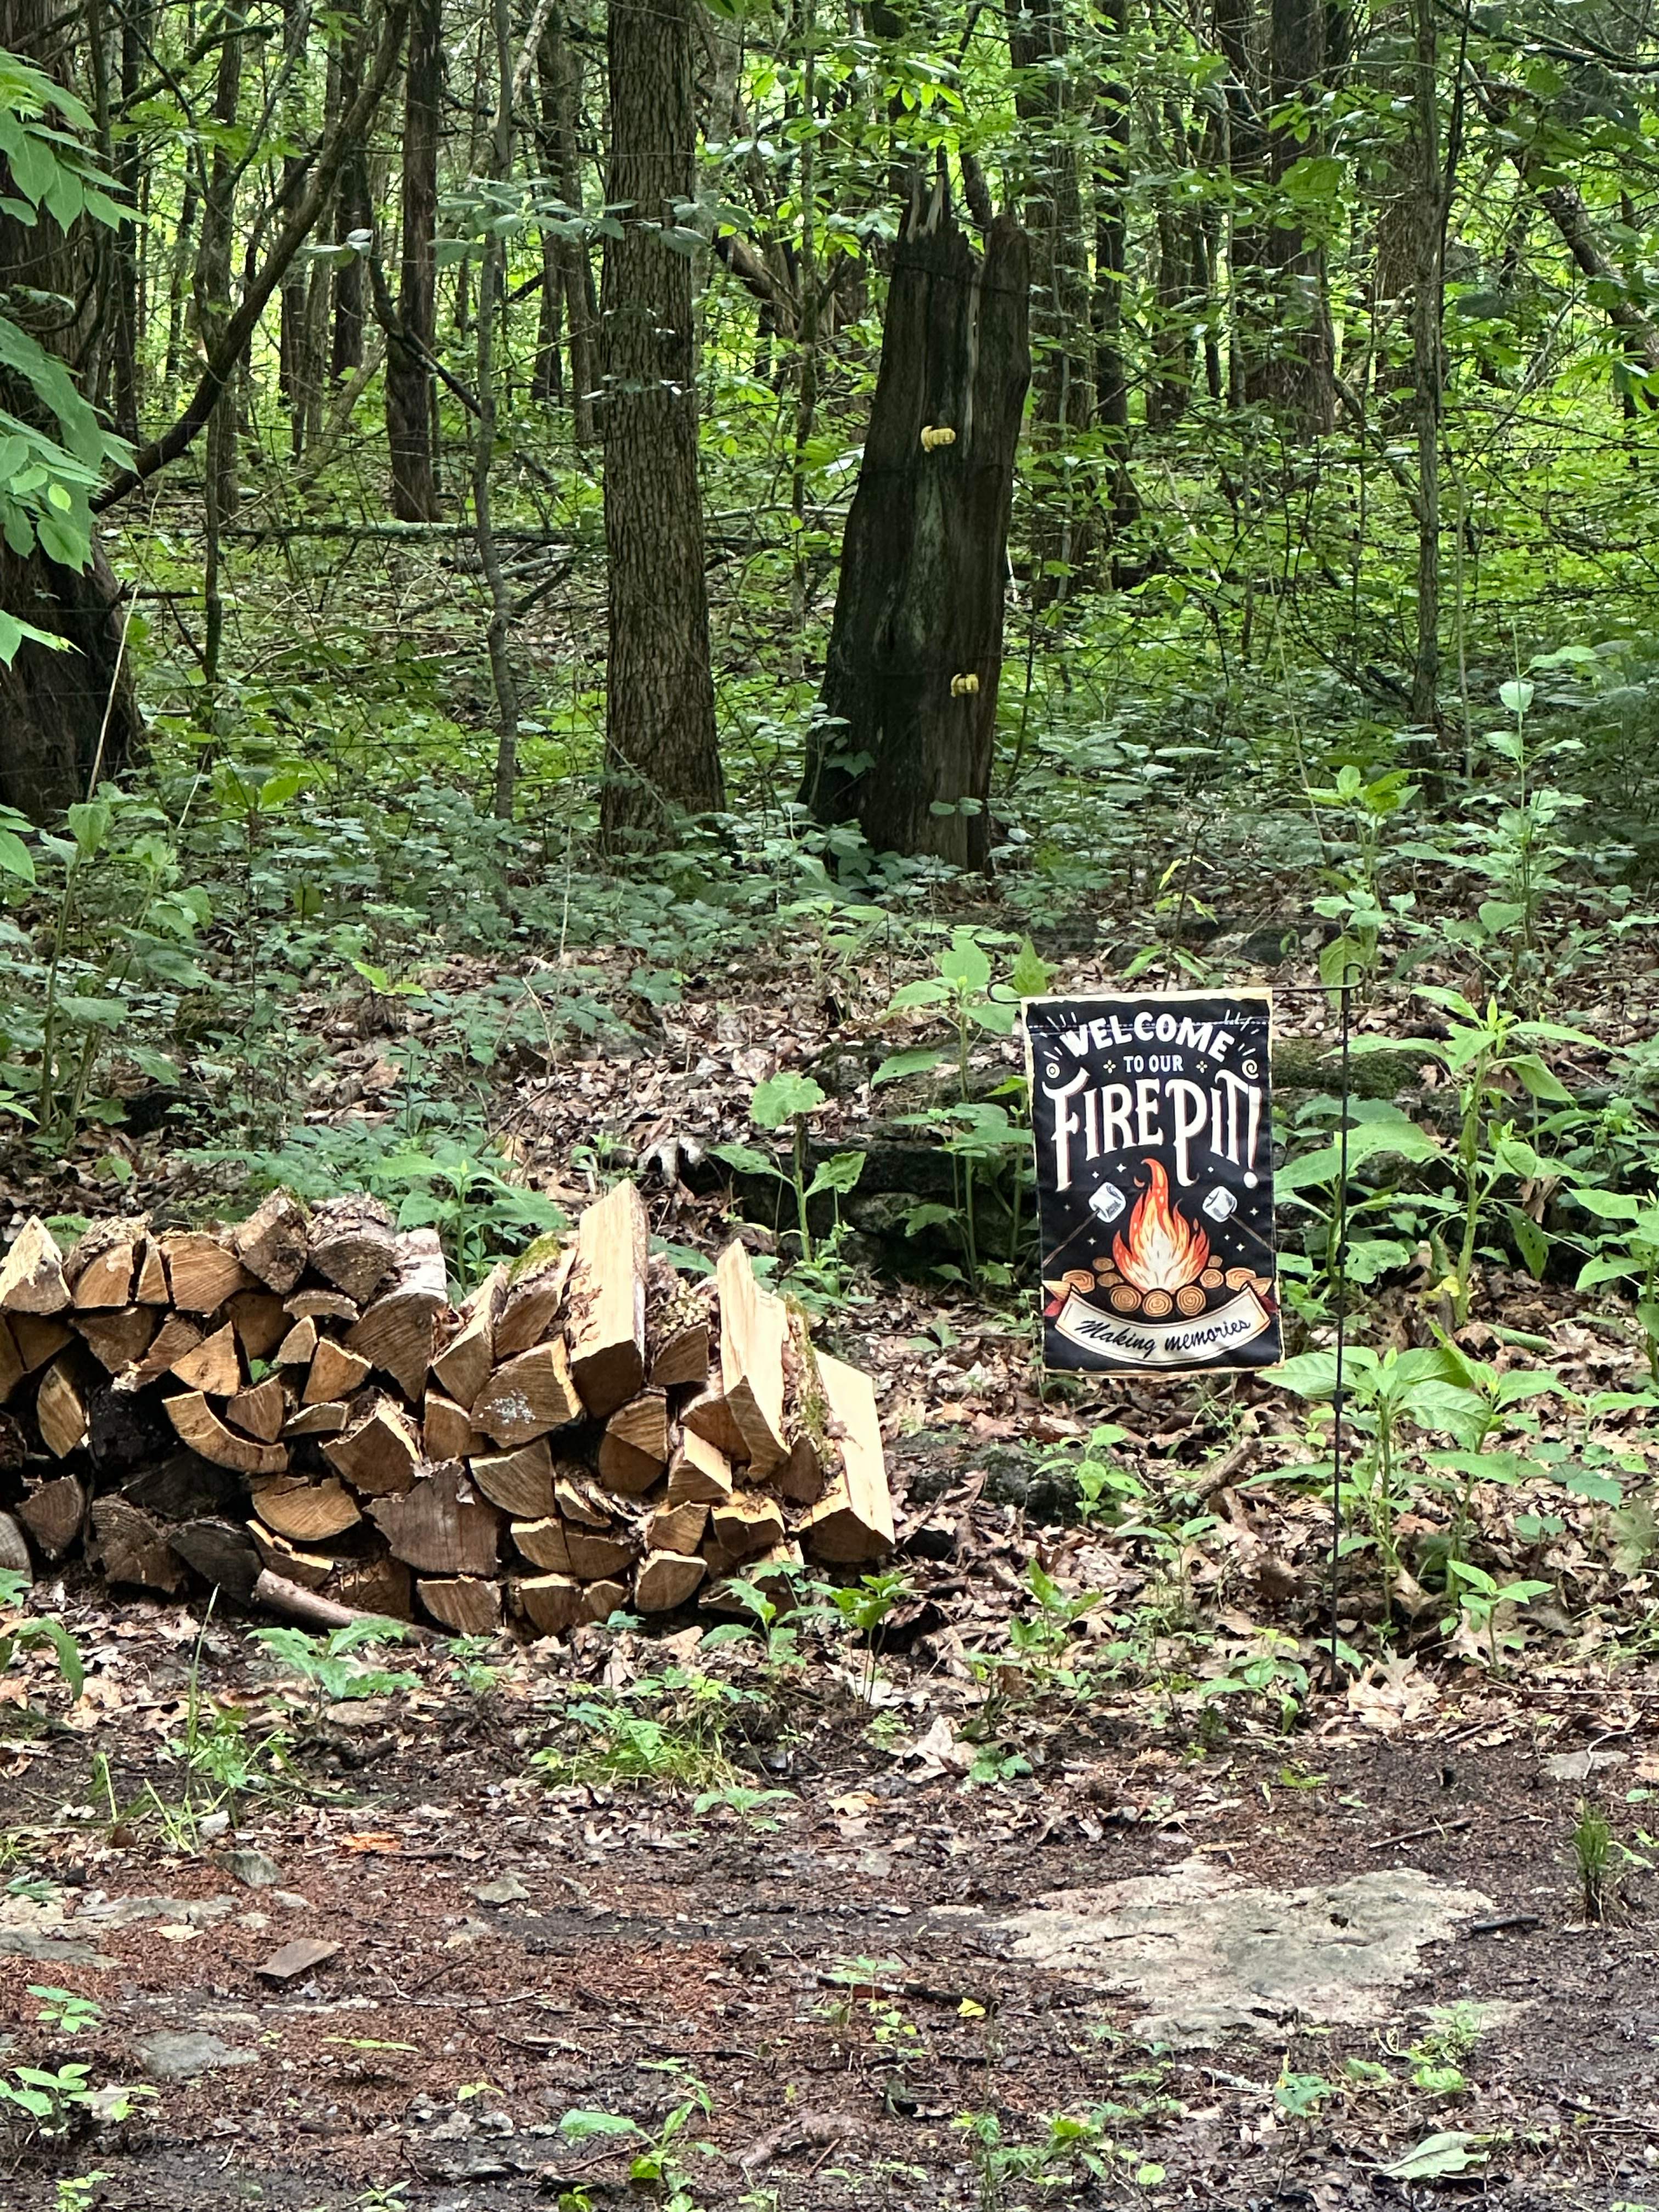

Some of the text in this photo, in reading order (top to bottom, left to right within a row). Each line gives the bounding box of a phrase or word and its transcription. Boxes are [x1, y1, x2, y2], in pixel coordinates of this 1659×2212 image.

[1059, 1011, 1235, 1063] WELCOME
[1124, 1054, 1184, 1073] TO OUR
[1042, 1066, 1262, 1192] FIRE PIT!
[1075, 1319, 1251, 1359] Making memories
